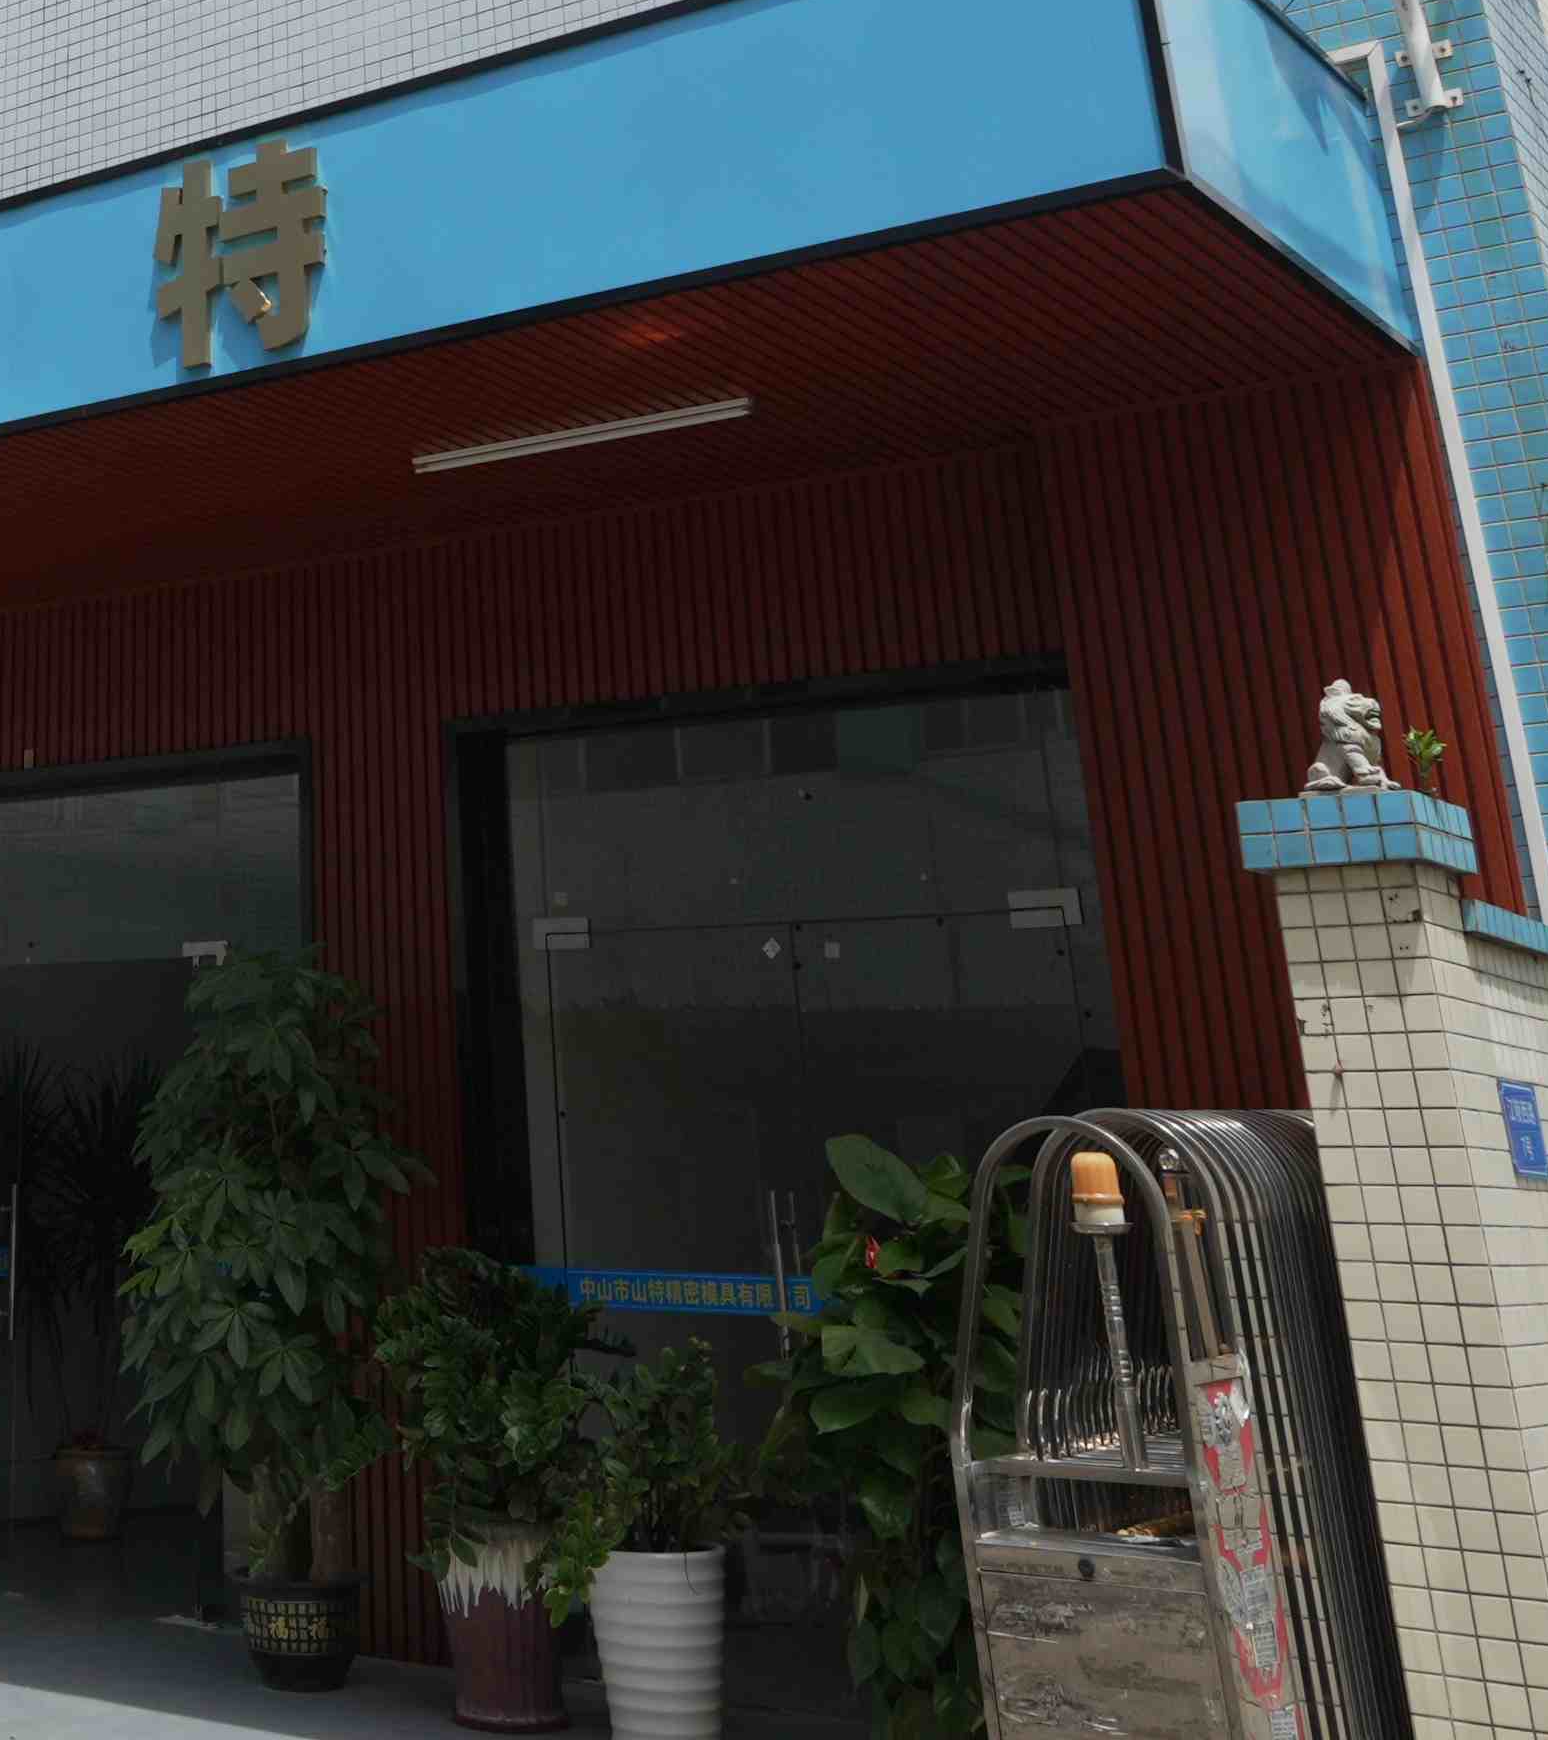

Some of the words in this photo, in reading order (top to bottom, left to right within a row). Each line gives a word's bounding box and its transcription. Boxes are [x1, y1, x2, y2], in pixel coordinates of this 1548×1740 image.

[579, 1276, 811, 1309] 中山市山特精密模具有限司
